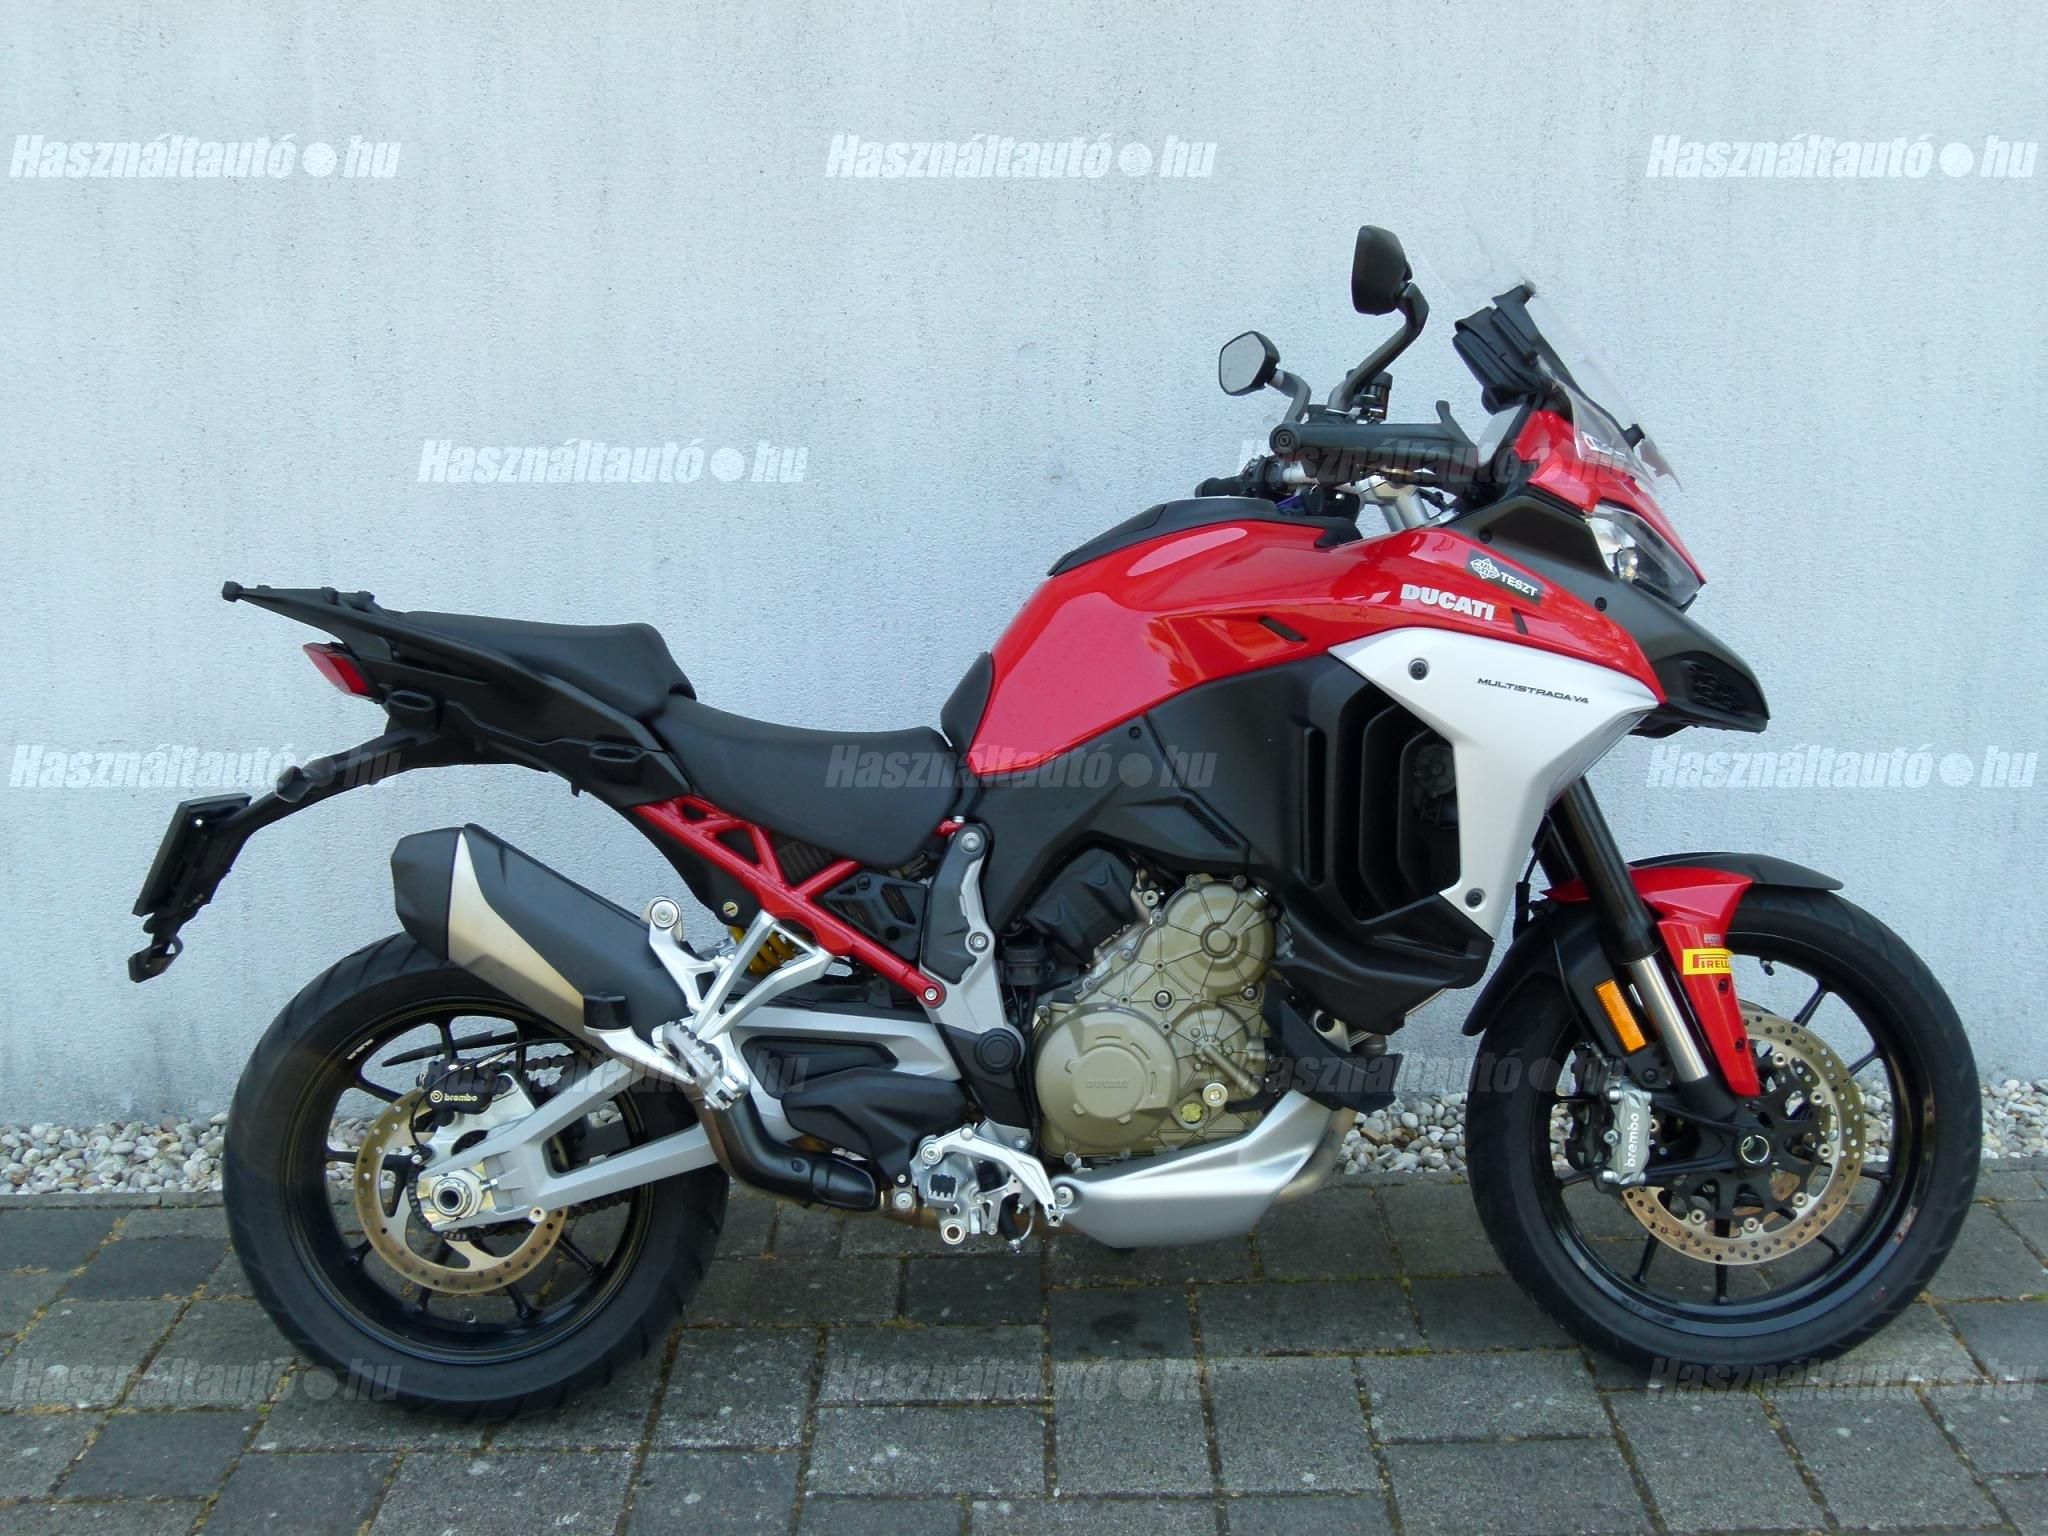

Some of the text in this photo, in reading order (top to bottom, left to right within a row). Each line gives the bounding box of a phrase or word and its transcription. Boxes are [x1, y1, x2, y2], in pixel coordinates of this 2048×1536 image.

[1501, 571, 1539, 597] TESZT
[1400, 583, 1495, 620] DUCATI
[1477, 678, 1589, 704] MULTISTRADA V4
[1692, 953, 1729, 969] PIRELL
[444, 1092, 478, 1102] brembo
[1624, 1113, 1639, 1167] brembo
